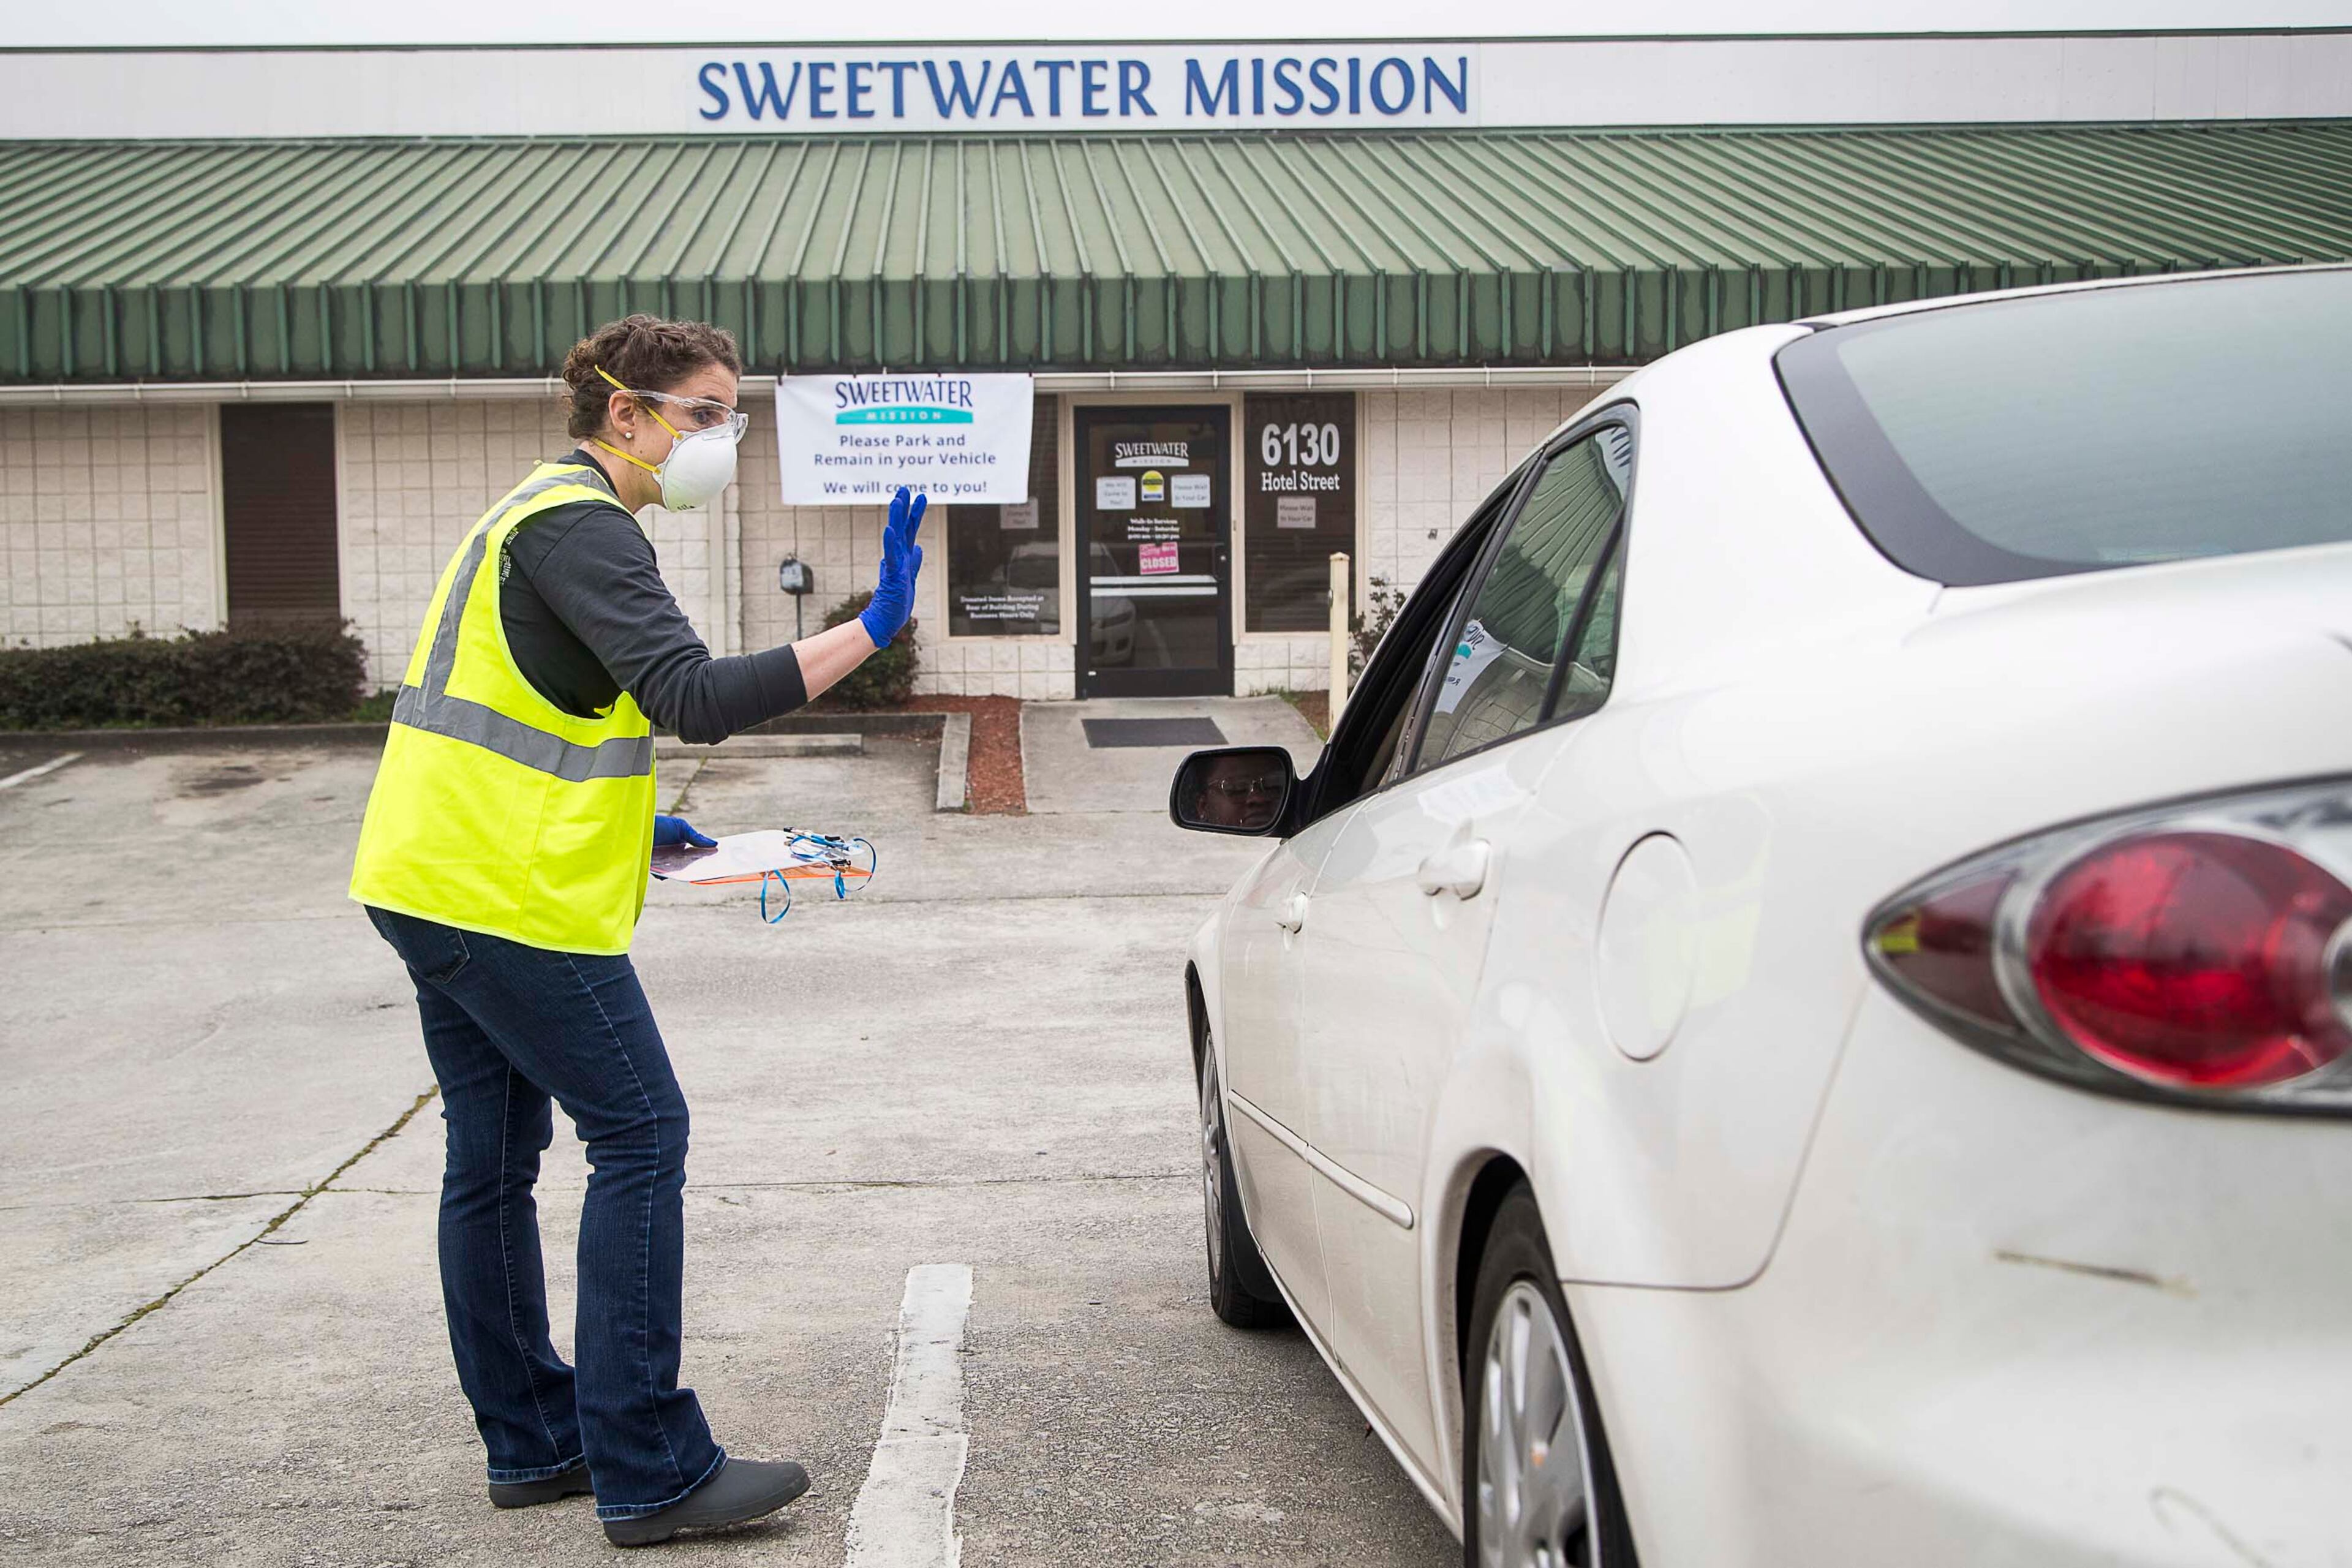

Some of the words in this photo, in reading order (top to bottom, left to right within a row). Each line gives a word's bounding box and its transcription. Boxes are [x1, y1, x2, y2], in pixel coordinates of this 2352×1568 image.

[698, 60, 1157, 121] SWEETWATER
[1185, 57, 1467, 117] MISSION
[835, 380, 973, 408] SWEETWATER
[866, 411, 941, 421] MISSION
[840, 435, 889, 447] Please
[896, 435, 930, 447] Park
[937, 434, 965, 447] and
[1262, 423, 1340, 466] 6130
[1115, 442, 1188, 459] SWEETWATER
[815, 454, 873, 466] Remain
[878, 454, 892, 465] in
[899, 456, 933, 468] your
[939, 453, 996, 465] Vehicle
[824, 482, 848, 494] We
[853, 481, 880, 494] will
[933, 483, 949, 493] to
[954, 481, 987, 496] you!
[1262, 470, 1297, 491] Hotel
[1300, 471, 1340, 491] Street
[1140, 557, 1177, 570] CLOSED
